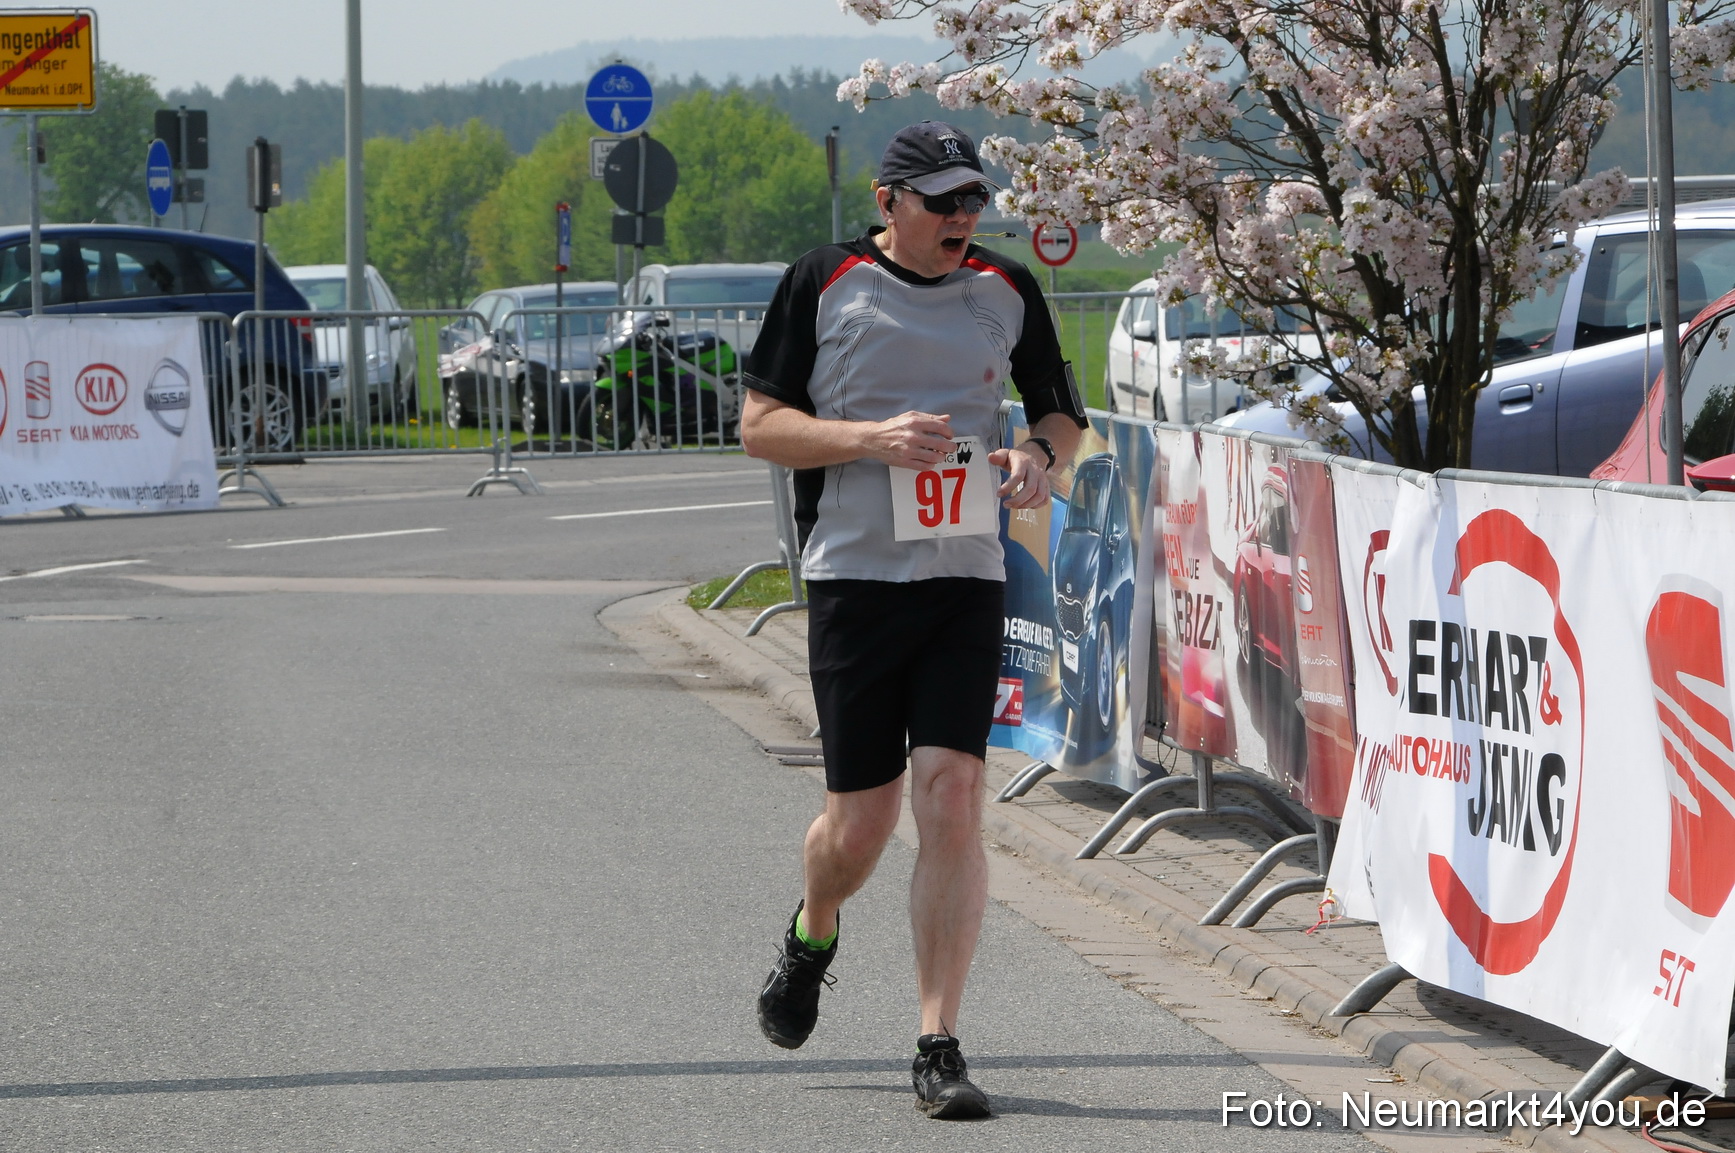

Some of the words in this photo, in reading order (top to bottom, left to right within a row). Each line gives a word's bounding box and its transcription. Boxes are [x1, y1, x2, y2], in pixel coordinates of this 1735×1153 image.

[23, 57, 68, 74] Anger
[4, 84, 50, 96] Neumarkt
[84, 376, 118, 403] KIA
[17, 428, 62, 443] SEAT
[70, 426, 90, 441] KIA
[93, 424, 140, 441] MOTORS
[915, 467, 967, 528] 97
[1300, 623, 1324, 642] EAT
[1401, 619, 1548, 737] ERHART
[1539, 660, 1563, 726] &
[993, 683, 1015, 718] 7
[1388, 734, 1471, 785] AUTOHAUS
